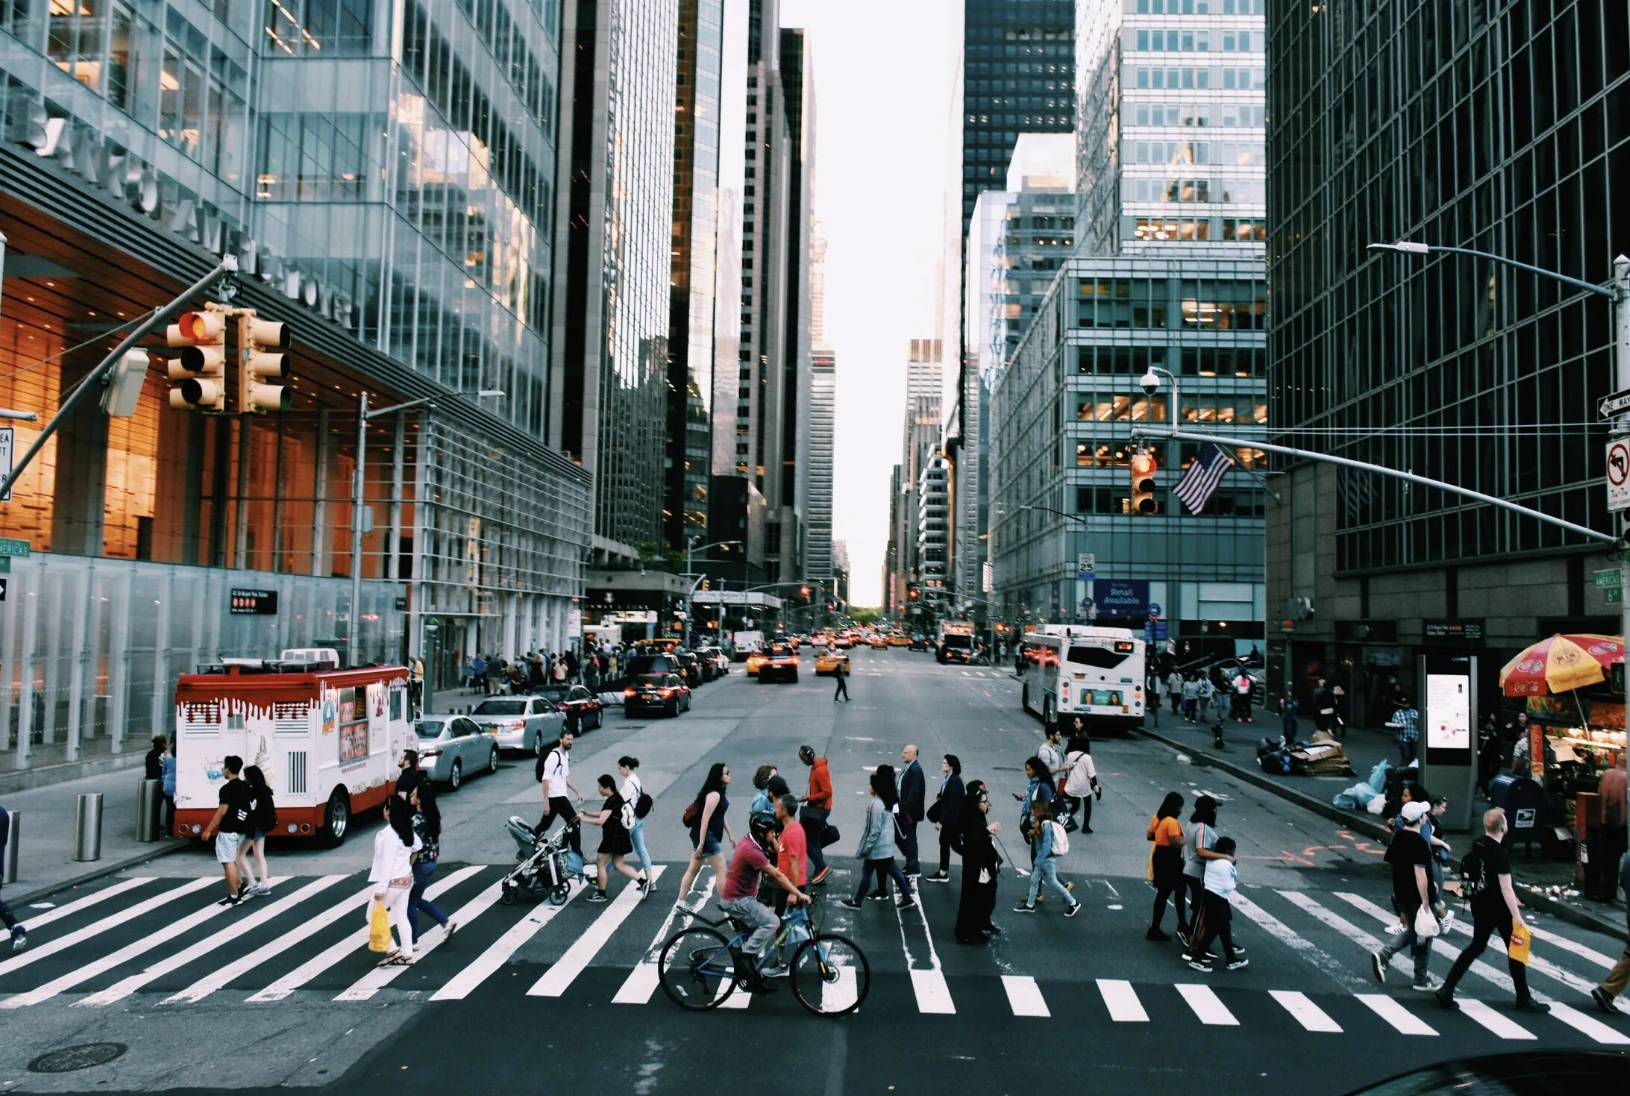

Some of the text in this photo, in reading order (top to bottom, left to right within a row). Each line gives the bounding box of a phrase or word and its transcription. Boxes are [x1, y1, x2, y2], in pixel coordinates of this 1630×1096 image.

[1602, 401, 1614, 413] ONE
[1080, 563, 1094, 571] 25
[1110, 587, 1133, 596] Retail
[1104, 597, 1140, 605] Available
